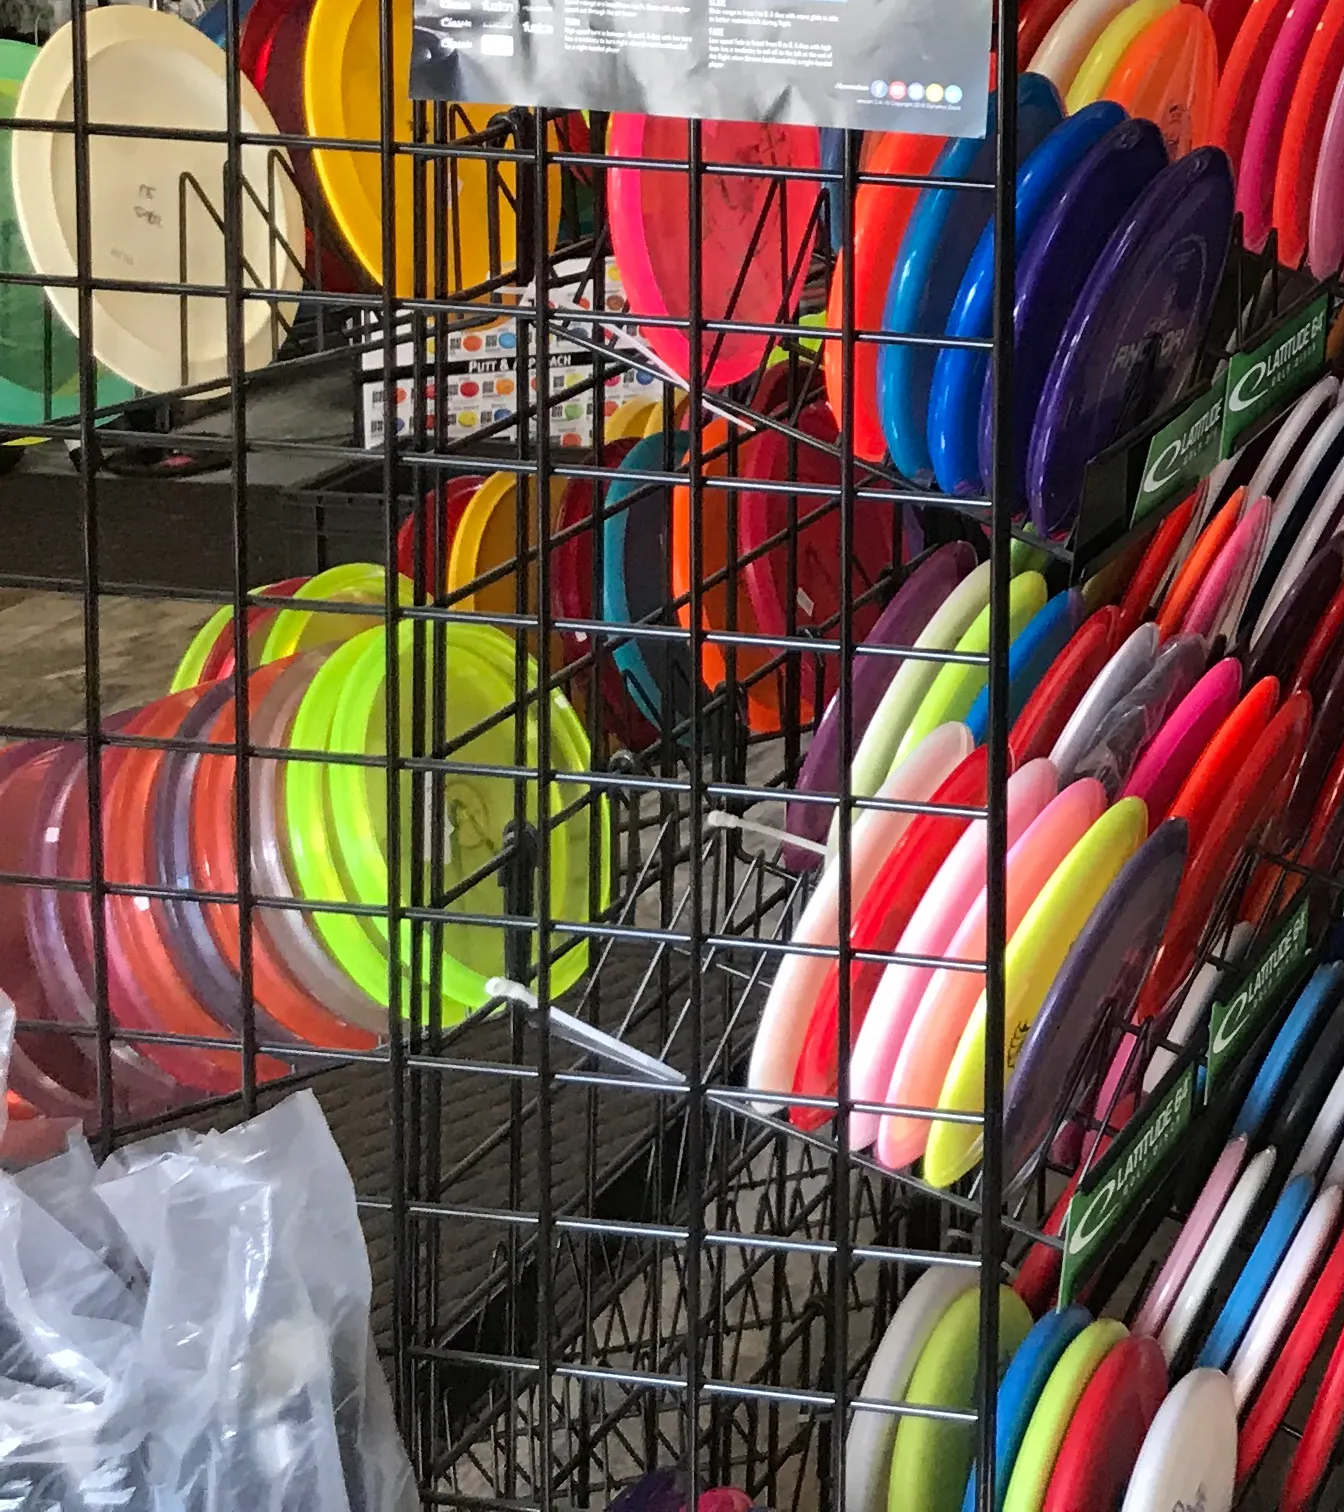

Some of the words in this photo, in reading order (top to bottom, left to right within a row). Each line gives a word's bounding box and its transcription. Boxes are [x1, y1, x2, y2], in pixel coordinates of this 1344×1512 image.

[468, 359, 497, 373] PUTT
[500, 359, 509, 371] &
[1267, 328, 1310, 376] LATITUDE
[1180, 397, 1223, 455] LATITUDE
[1248, 928, 1292, 1002] LATITUDE
[1117, 1100, 1175, 1191] LATITUDE
